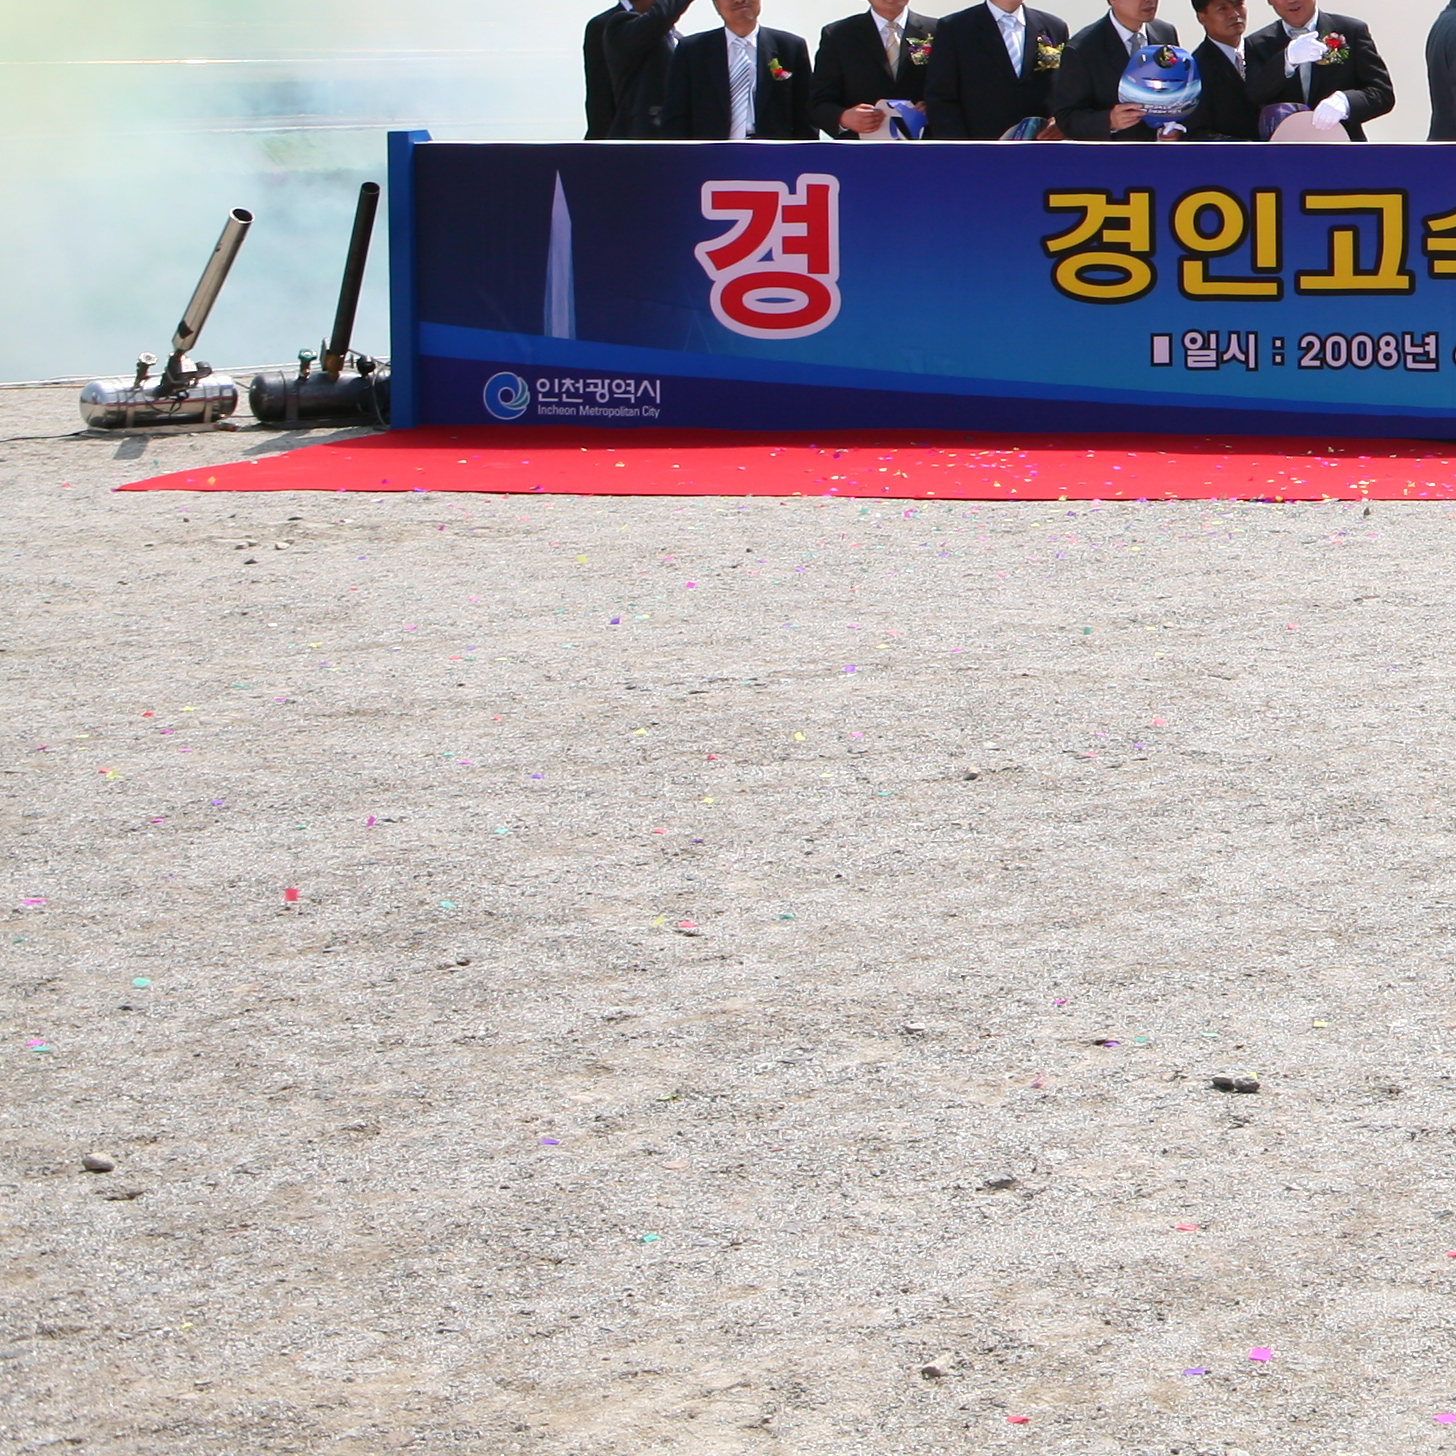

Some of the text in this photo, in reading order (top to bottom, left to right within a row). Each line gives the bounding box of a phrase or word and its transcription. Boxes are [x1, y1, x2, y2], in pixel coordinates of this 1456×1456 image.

[695, 173, 841, 340] 경
[1182, 330, 1258, 371] 일시
[1298, 331, 1439, 371] 2008년
[535, 377, 661, 404] 인천광역시
[537, 405, 661, 420] Incheon Metropolitan City
